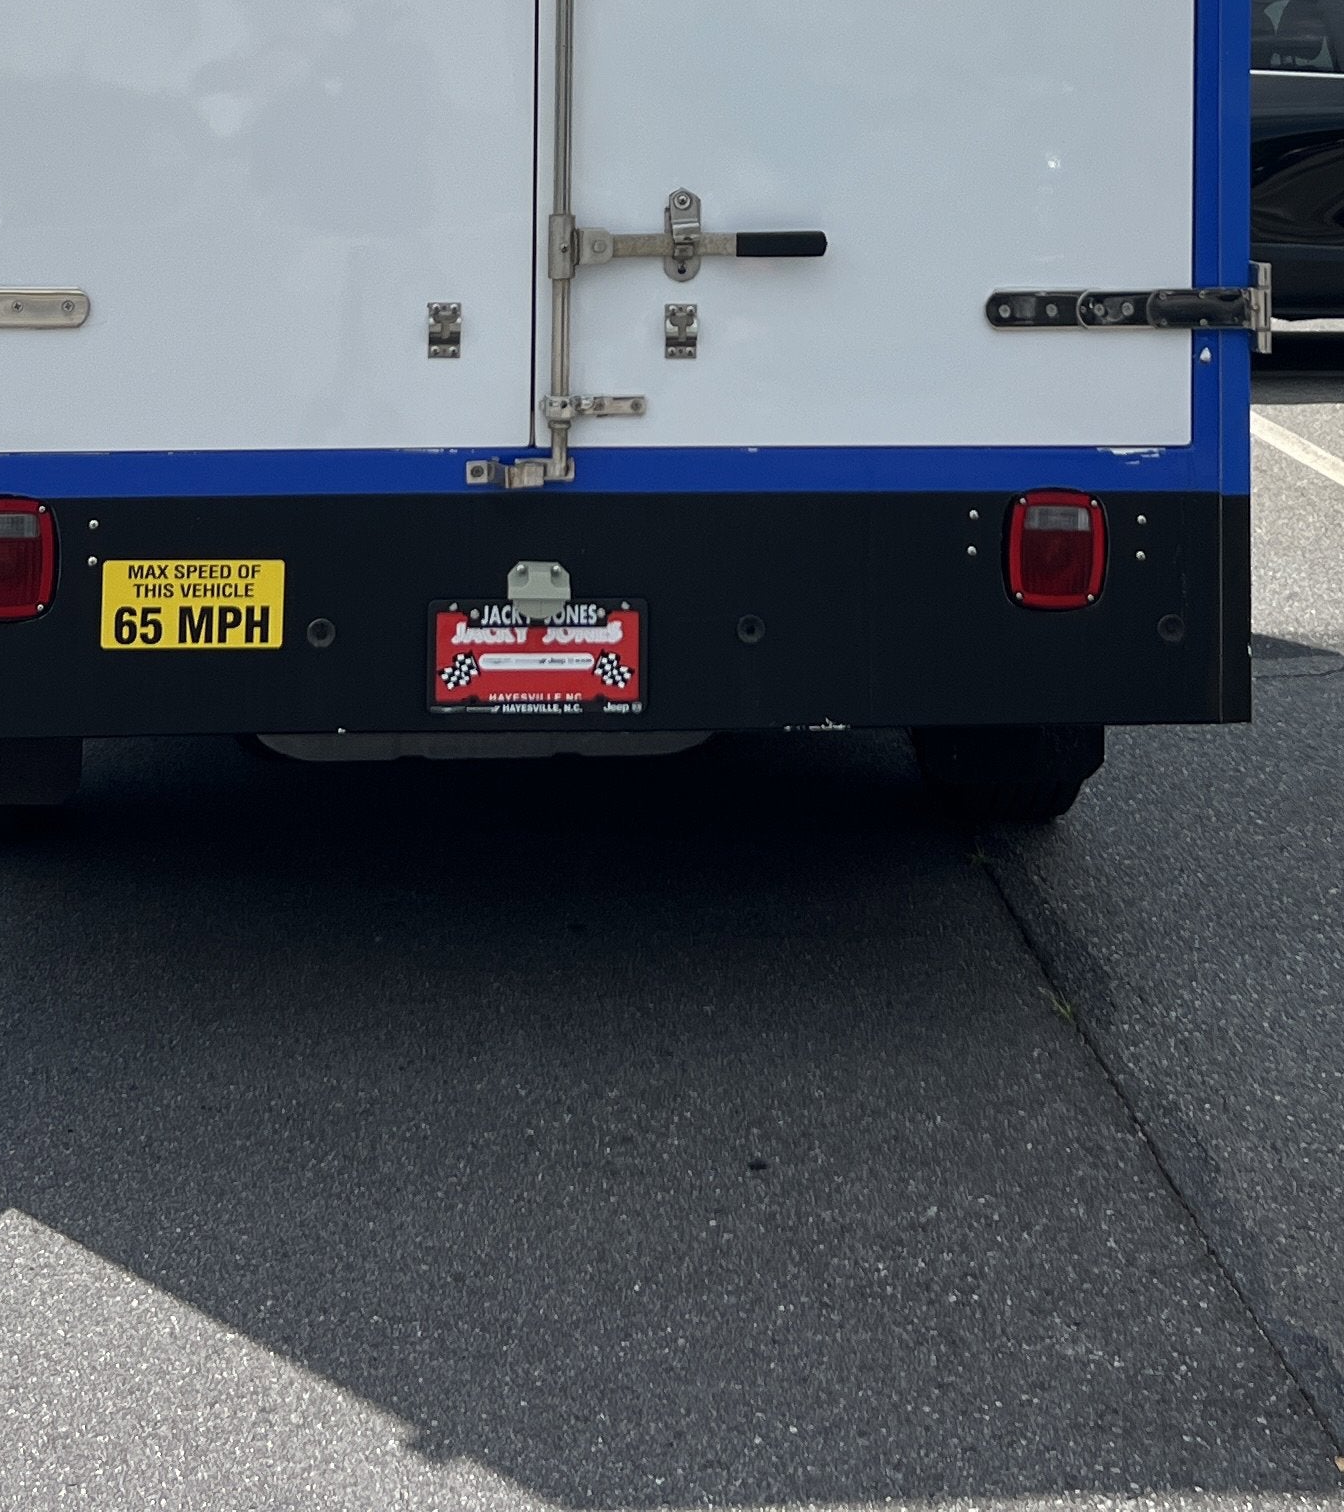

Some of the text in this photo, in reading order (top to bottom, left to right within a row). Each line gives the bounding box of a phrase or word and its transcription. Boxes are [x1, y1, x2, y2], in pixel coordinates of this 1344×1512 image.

[127, 564, 261, 580] MAX SPEED OF
[133, 583, 255, 598] THIS VEHICLE
[113, 605, 270, 645] 65 MPH
